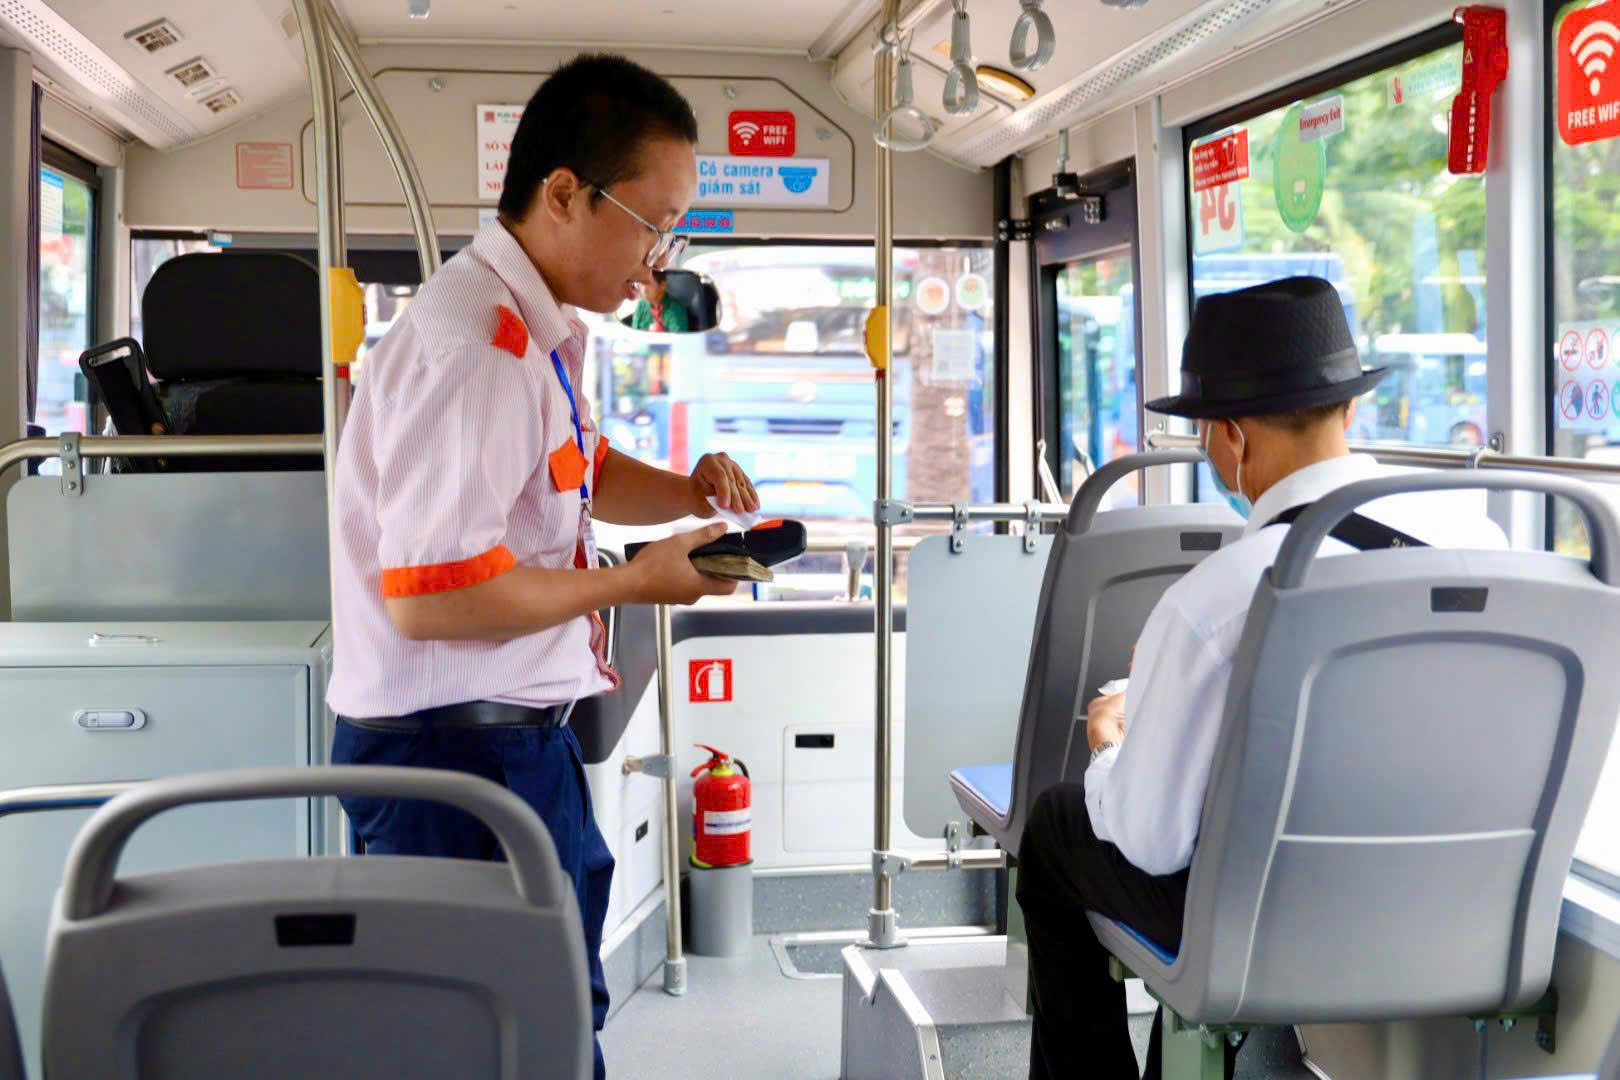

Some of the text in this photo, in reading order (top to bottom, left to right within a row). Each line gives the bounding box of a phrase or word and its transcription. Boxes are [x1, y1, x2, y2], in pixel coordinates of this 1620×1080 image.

[1299, 106, 1341, 130] Emergency Exit
[1567, 106, 1596, 129] FREE
[762, 124, 788, 136] FREE
[699, 160, 774, 177] Có camera
[699, 180, 761, 197] giám sát
